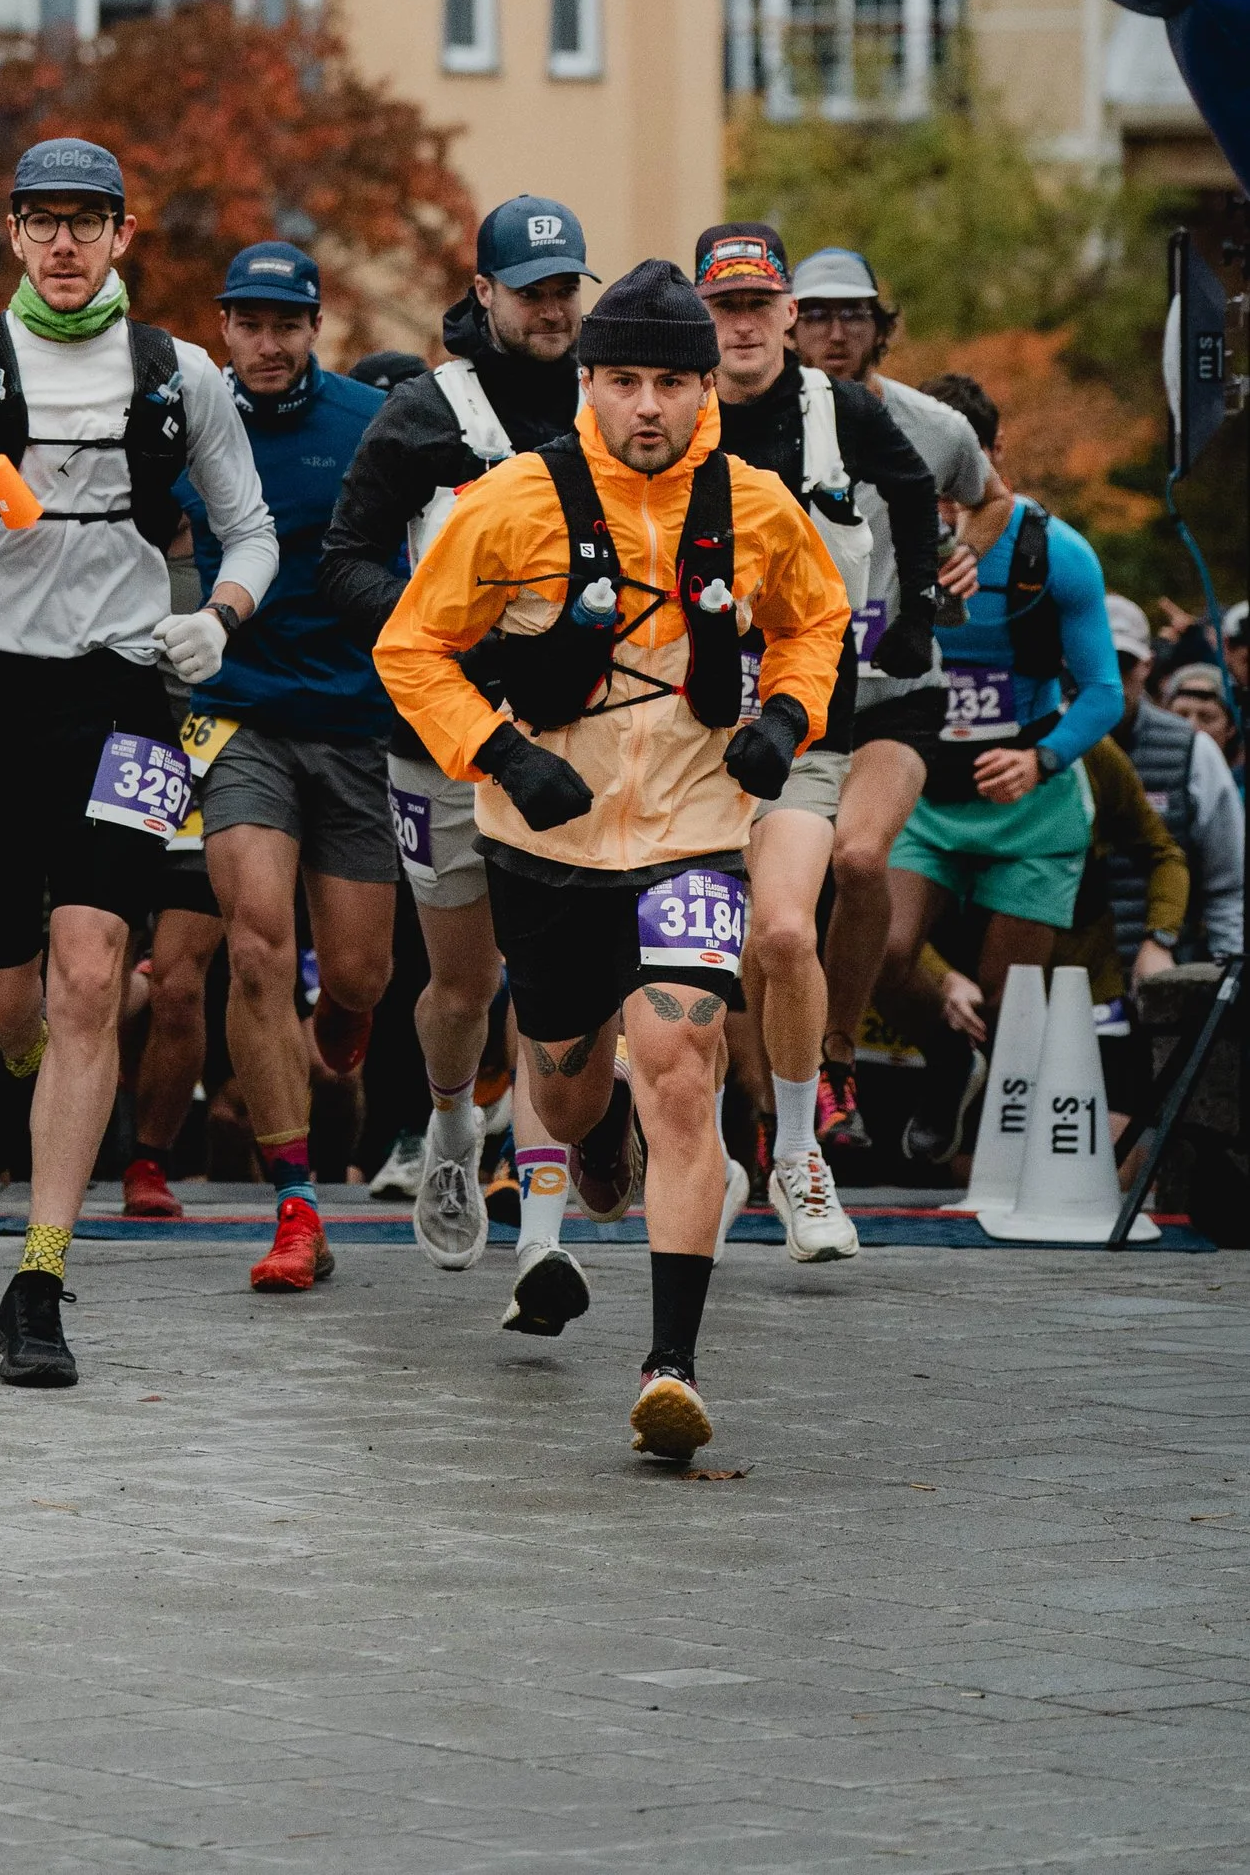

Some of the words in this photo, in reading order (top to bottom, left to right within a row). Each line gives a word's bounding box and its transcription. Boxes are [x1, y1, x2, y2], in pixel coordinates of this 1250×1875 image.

[43, 149, 92, 169] ciele
[534, 219, 552, 235] 51
[114, 761, 192, 822] 3297
[659, 897, 742, 948] 3184
[705, 939, 720, 949] FILIP
